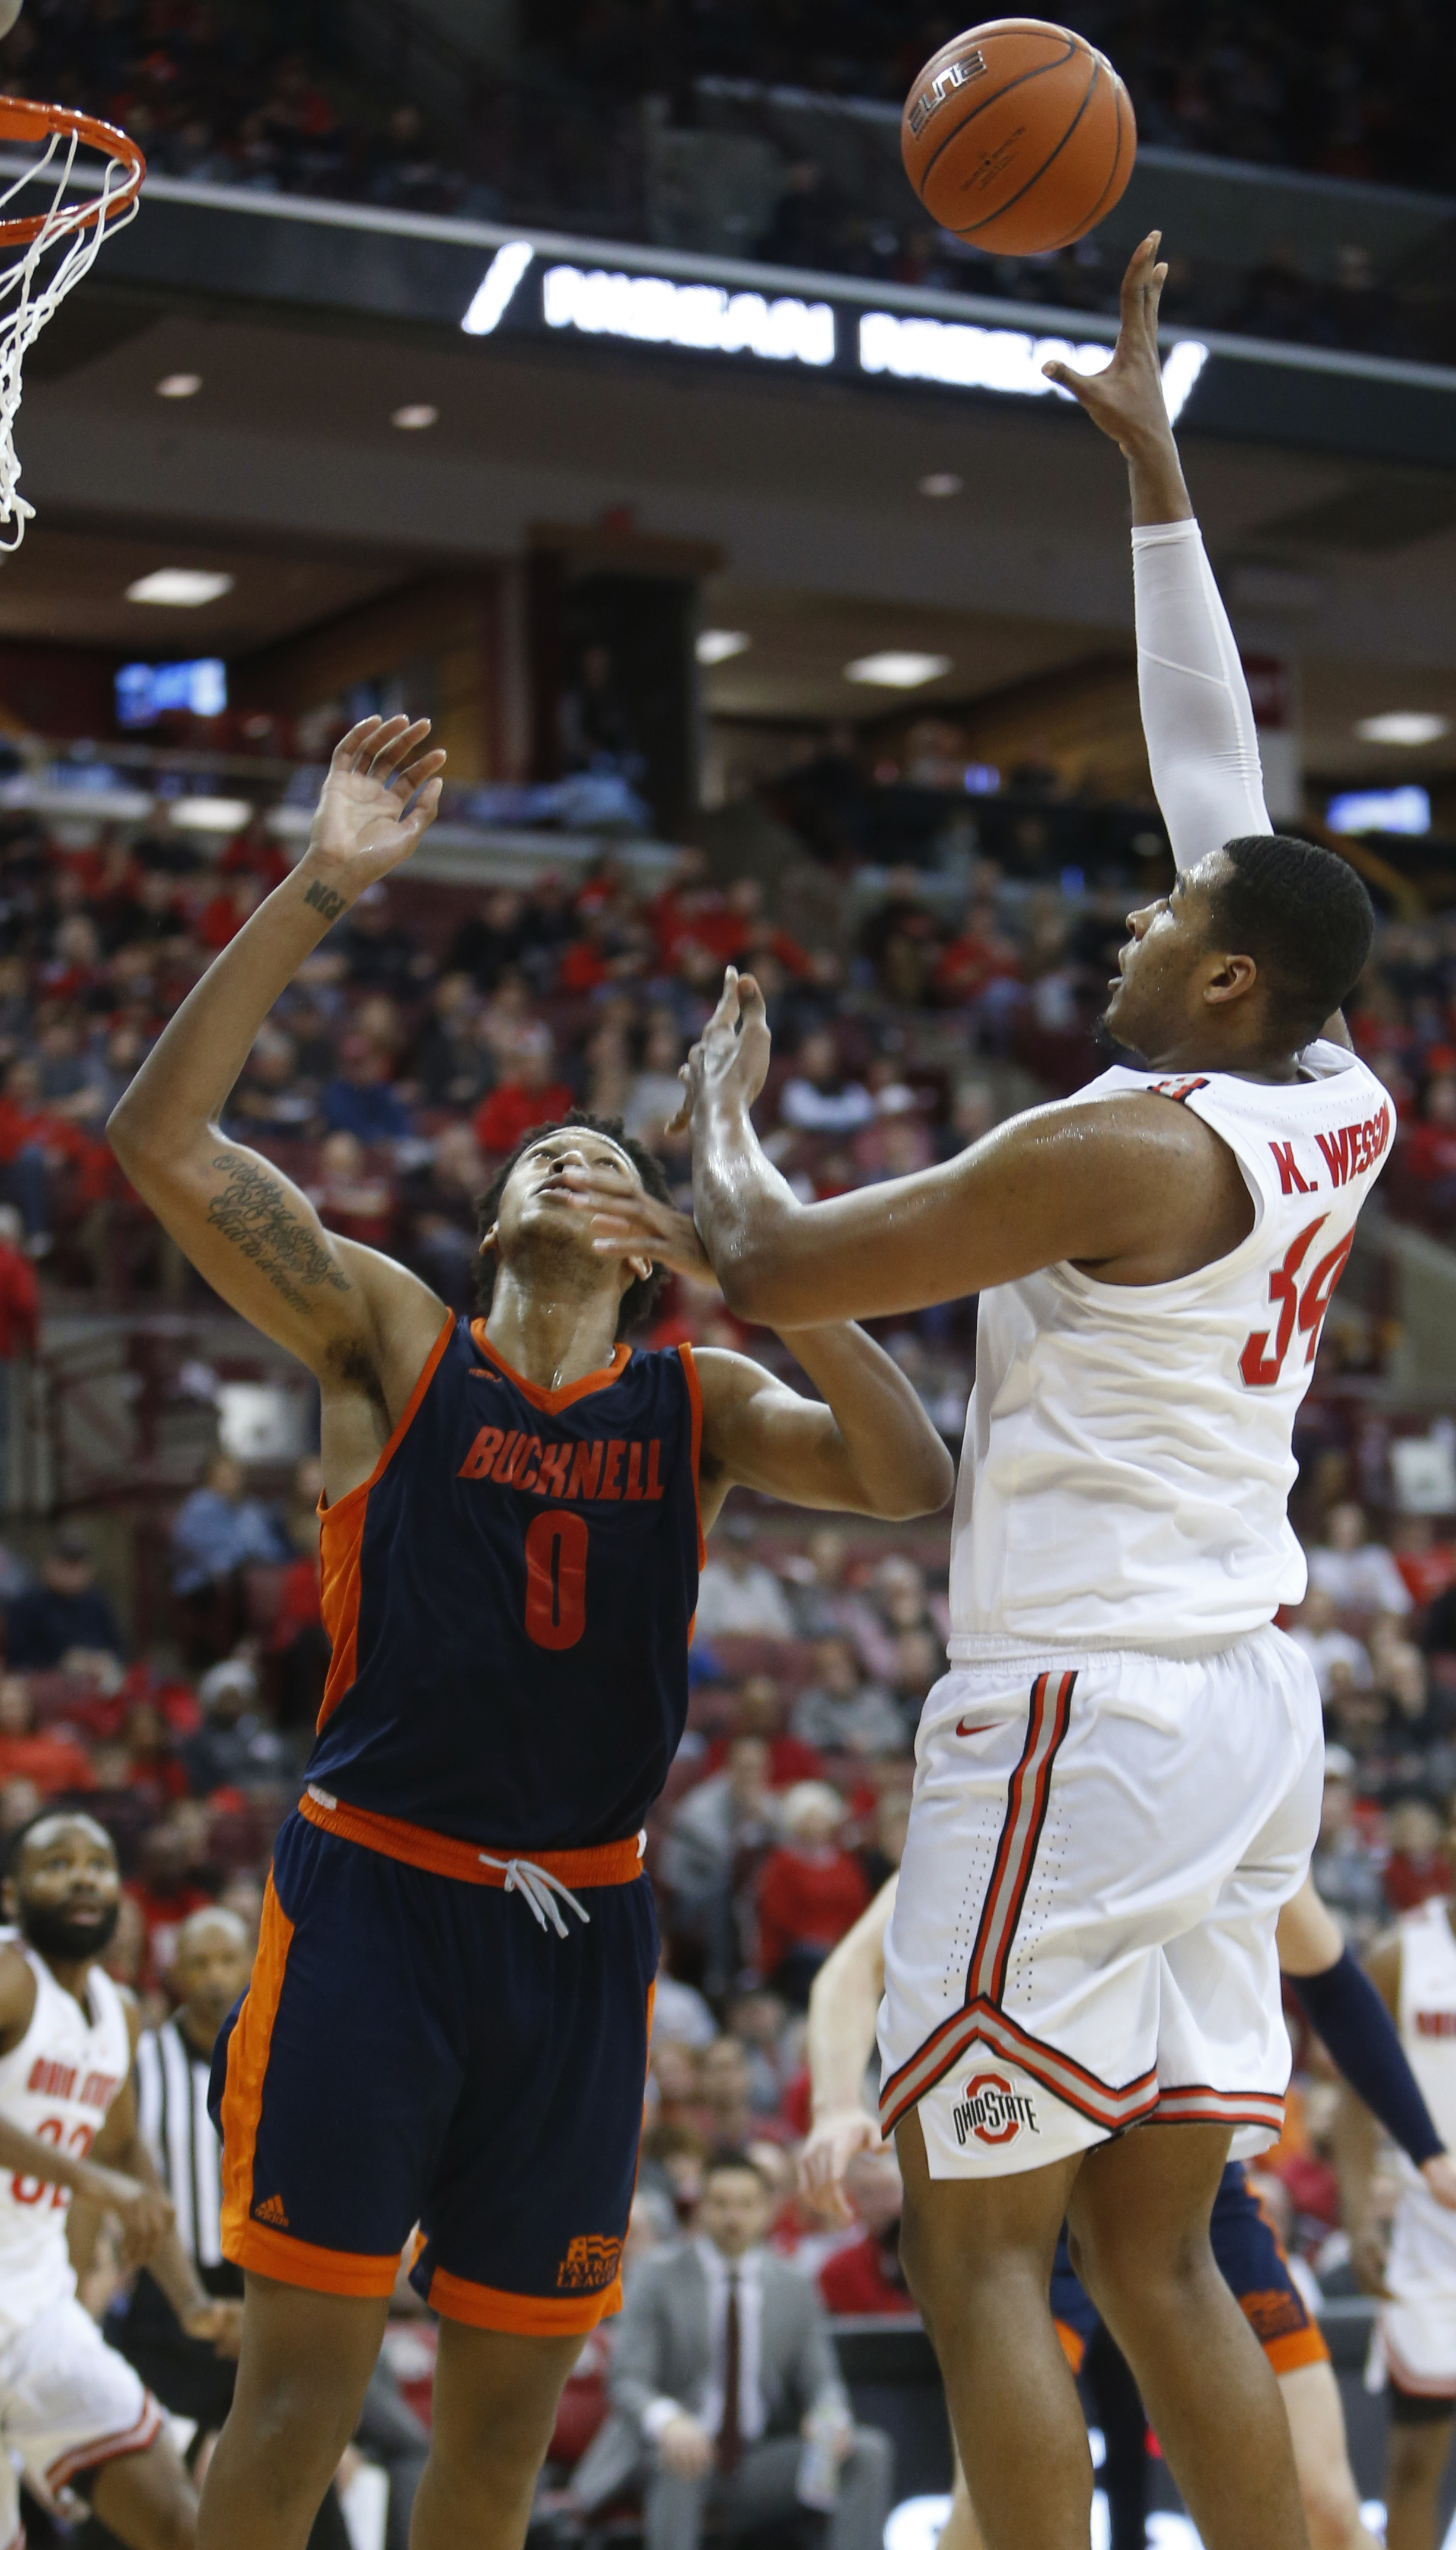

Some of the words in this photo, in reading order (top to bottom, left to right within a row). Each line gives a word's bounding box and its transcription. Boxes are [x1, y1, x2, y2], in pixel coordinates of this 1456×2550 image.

[1269, 1142, 1318, 1194] K.
[1237, 1212, 1356, 1386] 34
[456, 1425, 664, 1500] BUCKNELL
[525, 1510, 588, 1650] 0
[953, 2098, 986, 2145] OHIO
[984, 2092, 1040, 2134] STATE
